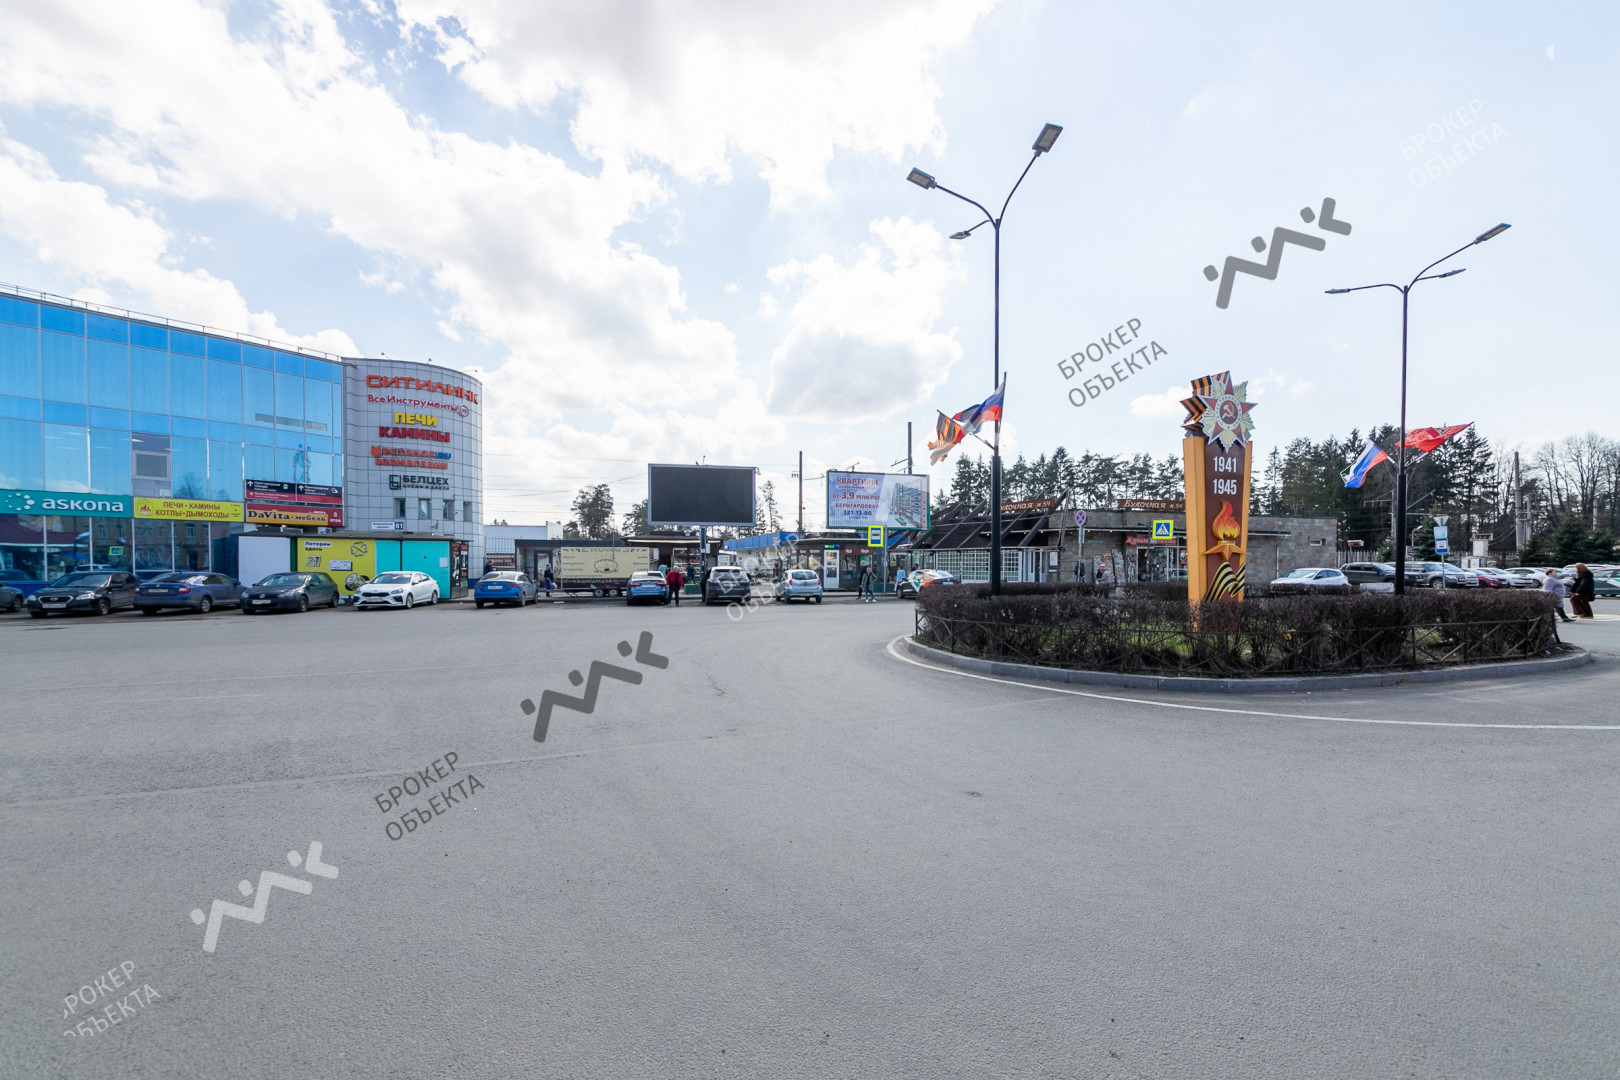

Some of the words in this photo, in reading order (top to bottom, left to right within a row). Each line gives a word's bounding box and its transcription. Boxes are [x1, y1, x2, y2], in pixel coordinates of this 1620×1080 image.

[366, 375, 478, 404] СИТИЛИНК
[394, 412, 438, 427] ПЕЧИ
[379, 426, 450, 442] КАМИНЫ
[1214, 456, 1236, 472] 1941
[403, 475, 448, 485] БЕЛЦЕХ
[1213, 479, 1237, 495] 1945
[841, 492, 854, 500] 3,9
[42, 498, 124, 512] askona
[248, 510, 290, 519] DaVita
